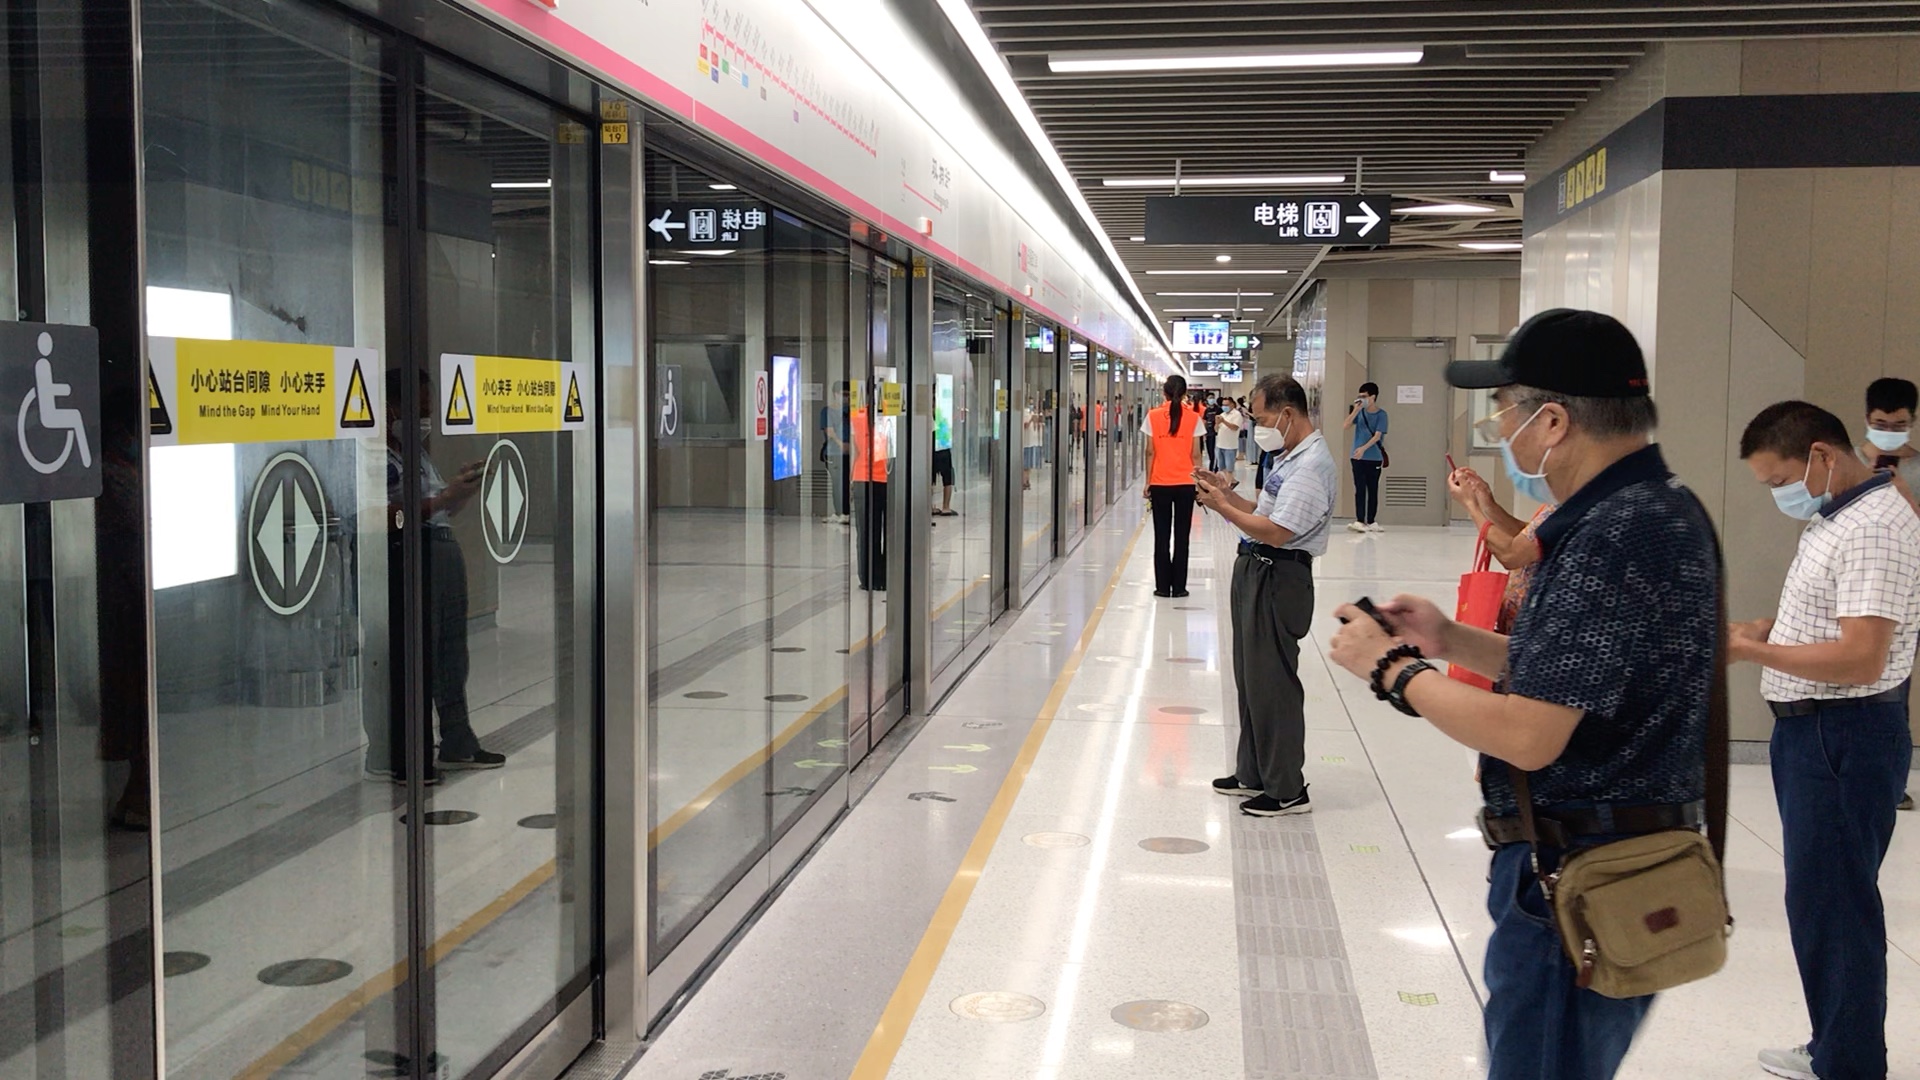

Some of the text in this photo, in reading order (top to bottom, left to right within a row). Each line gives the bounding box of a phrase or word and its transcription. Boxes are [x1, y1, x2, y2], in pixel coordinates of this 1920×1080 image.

[609, 133, 622, 142] 19
[1254, 202, 1299, 226] 电梯
[1279, 227, 1299, 238] Lift
[191, 368, 326, 394] 小心站台间隙 小心夹手
[483, 378, 556, 397] 小心夹手 小心站台间隙
[199, 404, 321, 420] Mind the Gap Mind Your Hand
[487, 404, 499, 413] Mind
[500, 404, 511, 413] Your
[511, 404, 524, 413] Hand
[525, 404, 536, 413] Mind
[544, 404, 553, 414] Gap
